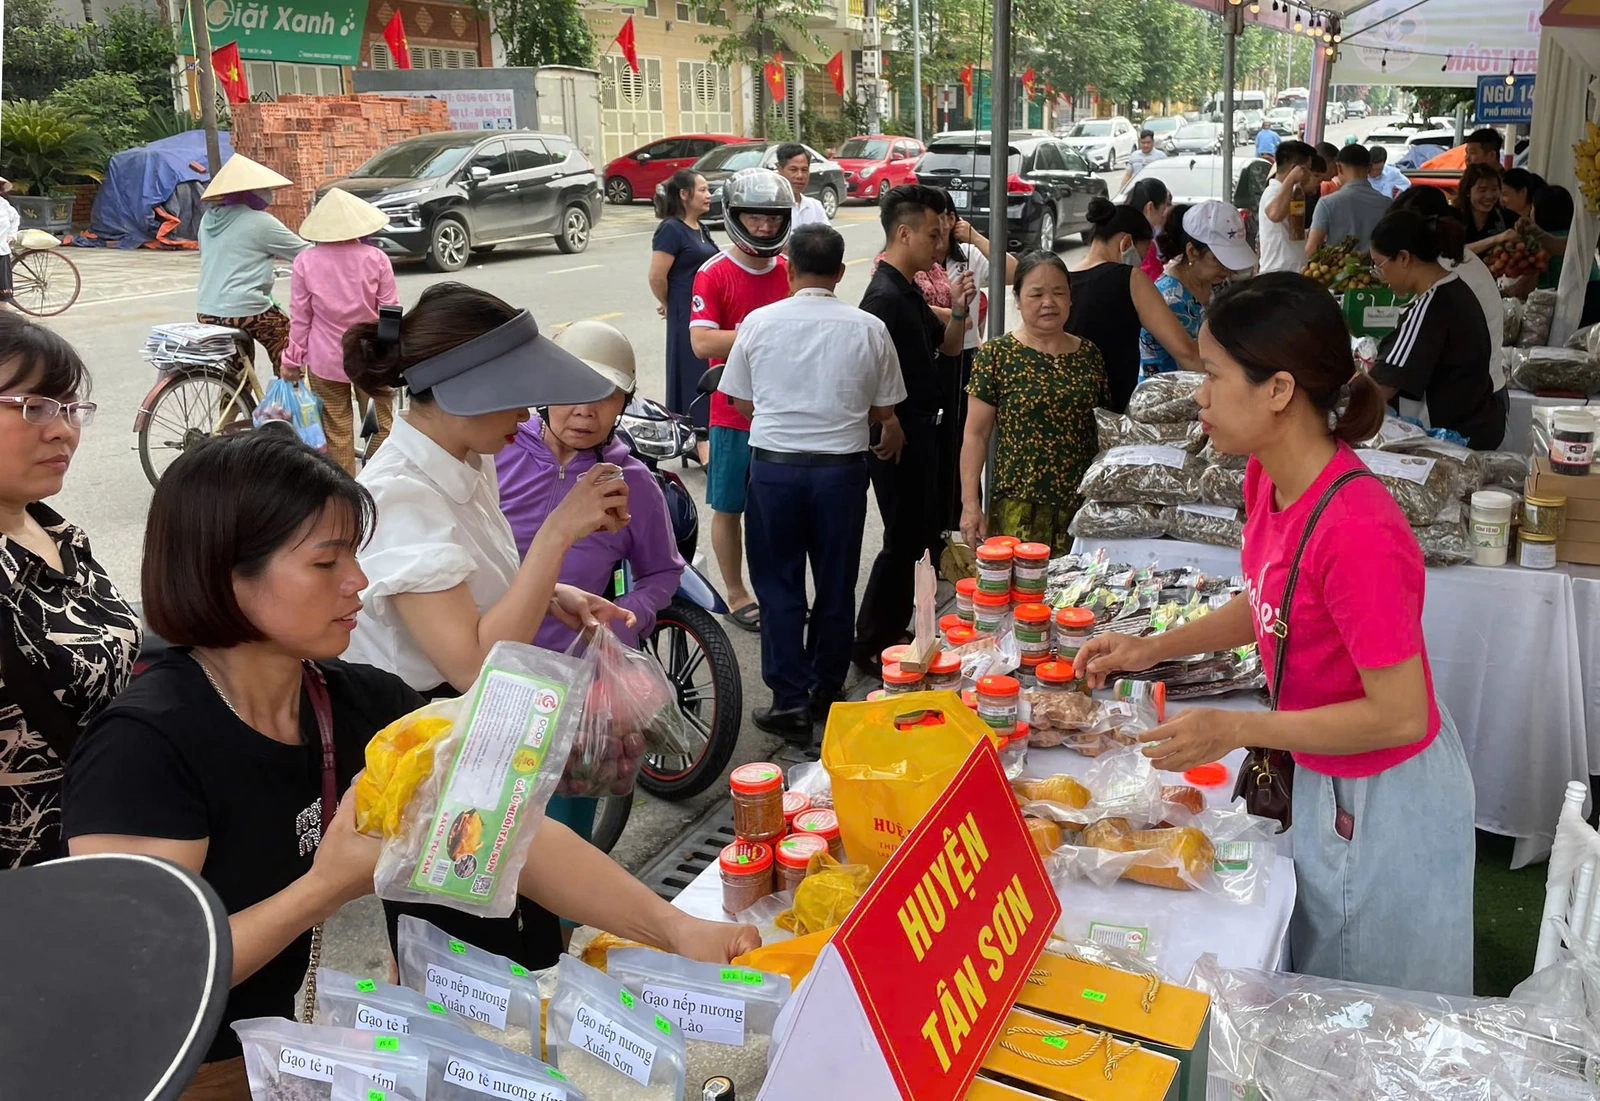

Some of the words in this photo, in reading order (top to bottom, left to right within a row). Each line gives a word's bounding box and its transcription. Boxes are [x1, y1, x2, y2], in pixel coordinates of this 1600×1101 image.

[206, 0, 268, 35] Giặt
[273, 6, 335, 35] Xanh
[1484, 105, 1500, 117] PHỐ
[1501, 107, 1521, 116] MINH
[535, 719, 547, 745] OCOP
[897, 811, 989, 963] HUYỆN
[427, 968, 448, 987] Gạo
[450, 976, 469, 997] nếp
[472, 989, 507, 1011] nương
[921, 954, 987, 1074] TÂN
[978, 873, 1034, 982] SƠN
[358, 1008, 382, 1028] Gạo
[386, 1018, 398, 1031] tẻ
[439, 993, 465, 1014] Xuân
[469, 1005, 490, 1023] Sơn
[642, 990, 669, 1008] Gạo
[673, 993, 696, 1015] nếp
[700, 1004, 743, 1023] nương
[577, 1007, 596, 1029] Gạo
[598, 1020, 616, 1043] nếp
[619, 1035, 653, 1066] nương
[680, 1017, 703, 1033] Lào
[280, 1048, 305, 1068] Gạo
[310, 1058, 321, 1072] tẻ
[583, 1035, 611, 1062] Xuân
[613, 1053, 633, 1076] Sơn
[447, 1060, 473, 1082] Gạo
[478, 1073, 489, 1087] tẻ
[493, 1081, 536, 1101] nương
